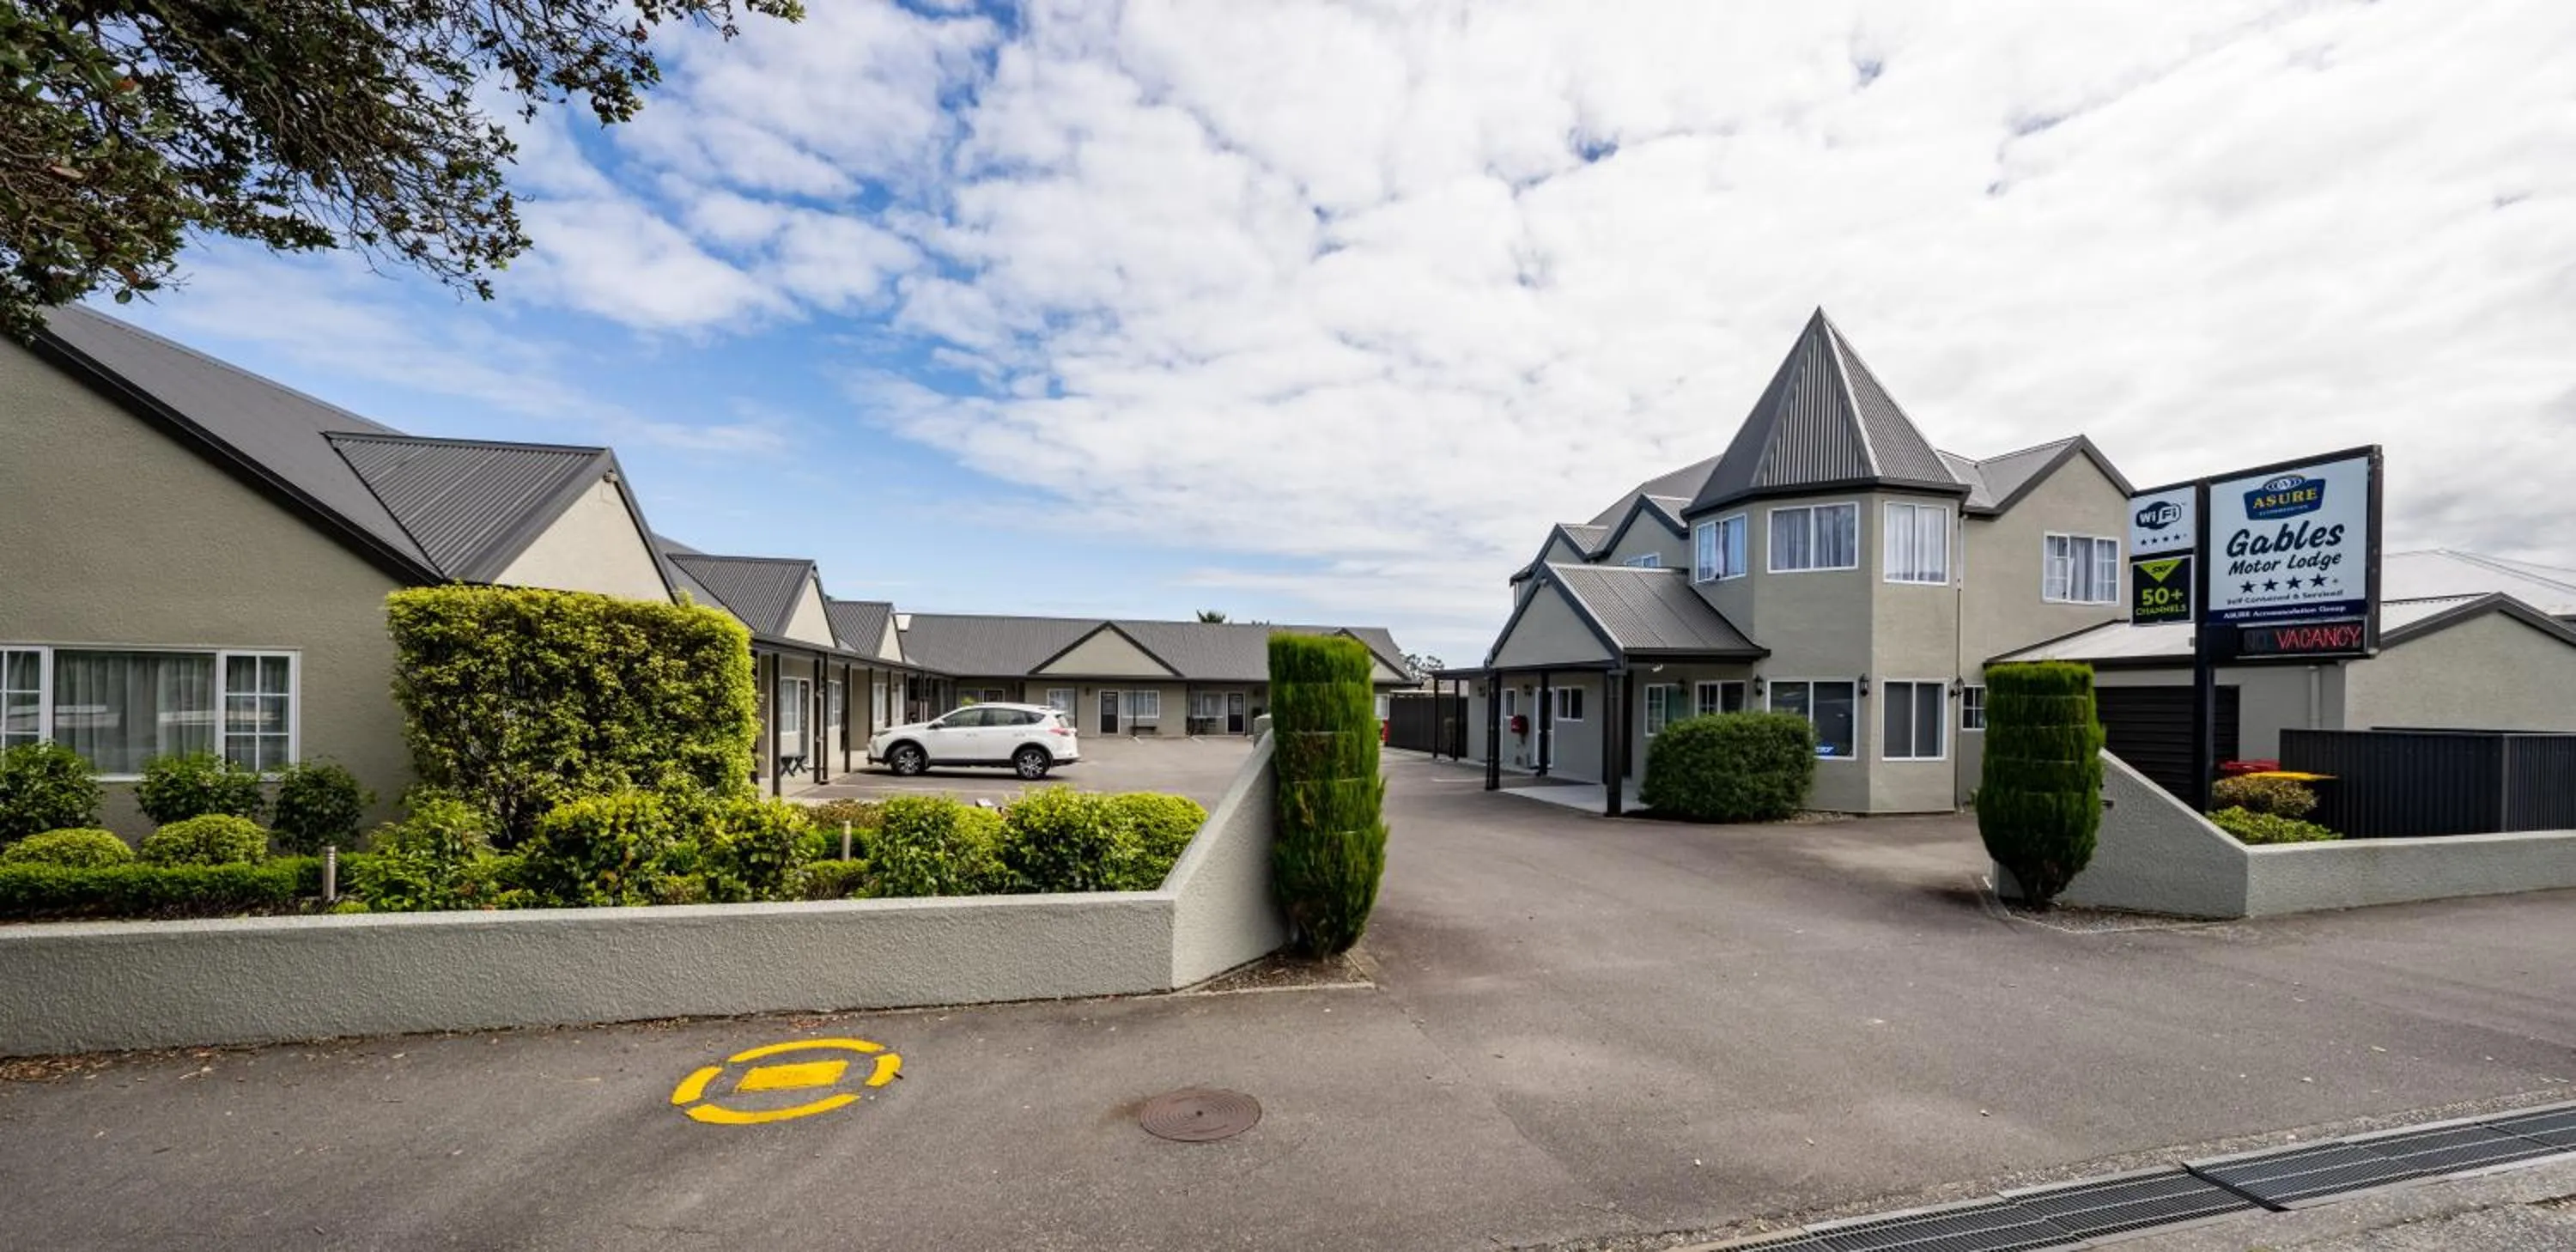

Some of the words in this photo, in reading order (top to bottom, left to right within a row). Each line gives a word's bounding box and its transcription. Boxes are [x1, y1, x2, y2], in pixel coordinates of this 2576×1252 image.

[2253, 489, 2318, 509] ASURE
[2227, 520, 2344, 557] Gables
[2228, 560, 2281, 575] Motor
[2287, 551, 2342, 571] Lodge
[2142, 588, 2184, 605] 50+
[2136, 604, 2187, 616] CHANNELS
[2276, 626, 2361, 649] VACANCY
